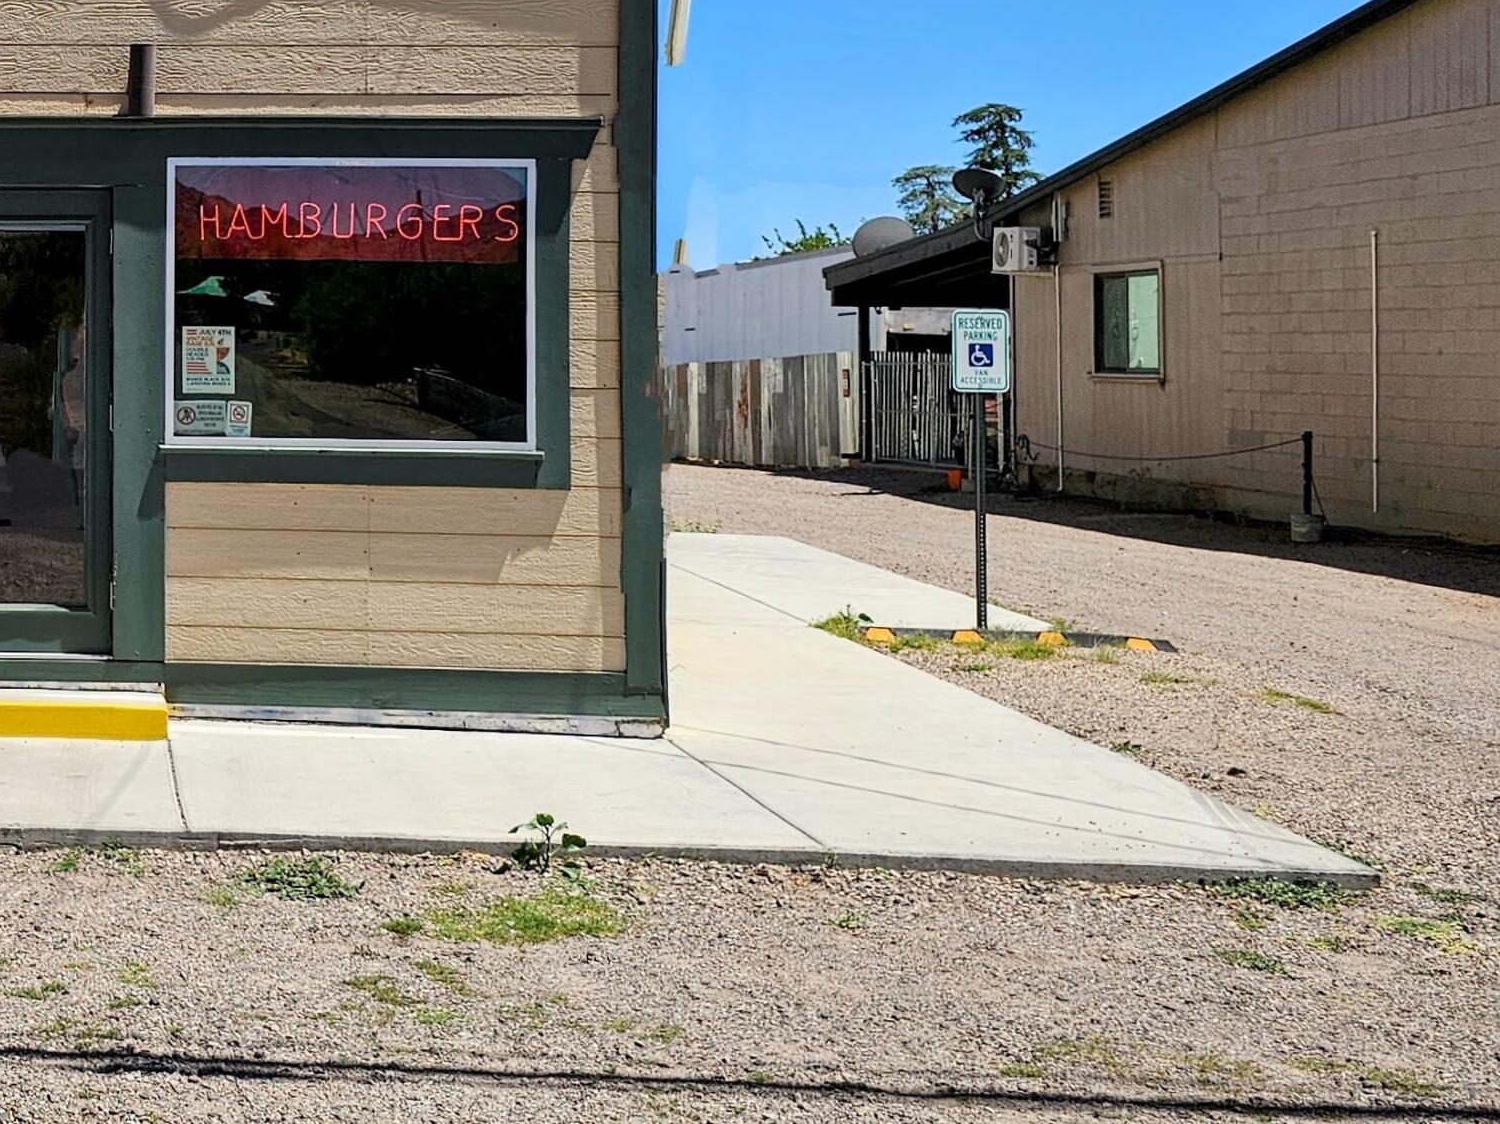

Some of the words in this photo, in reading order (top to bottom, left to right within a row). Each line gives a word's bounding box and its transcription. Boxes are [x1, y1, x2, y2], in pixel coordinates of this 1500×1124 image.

[200, 202, 519, 242] HAMBURGERS
[958, 317, 1003, 330] RESERVED
[963, 330, 998, 341] PARKING
[975, 369, 988, 377] VAN
[960, 376, 1002, 384] ACCESSIBLE
